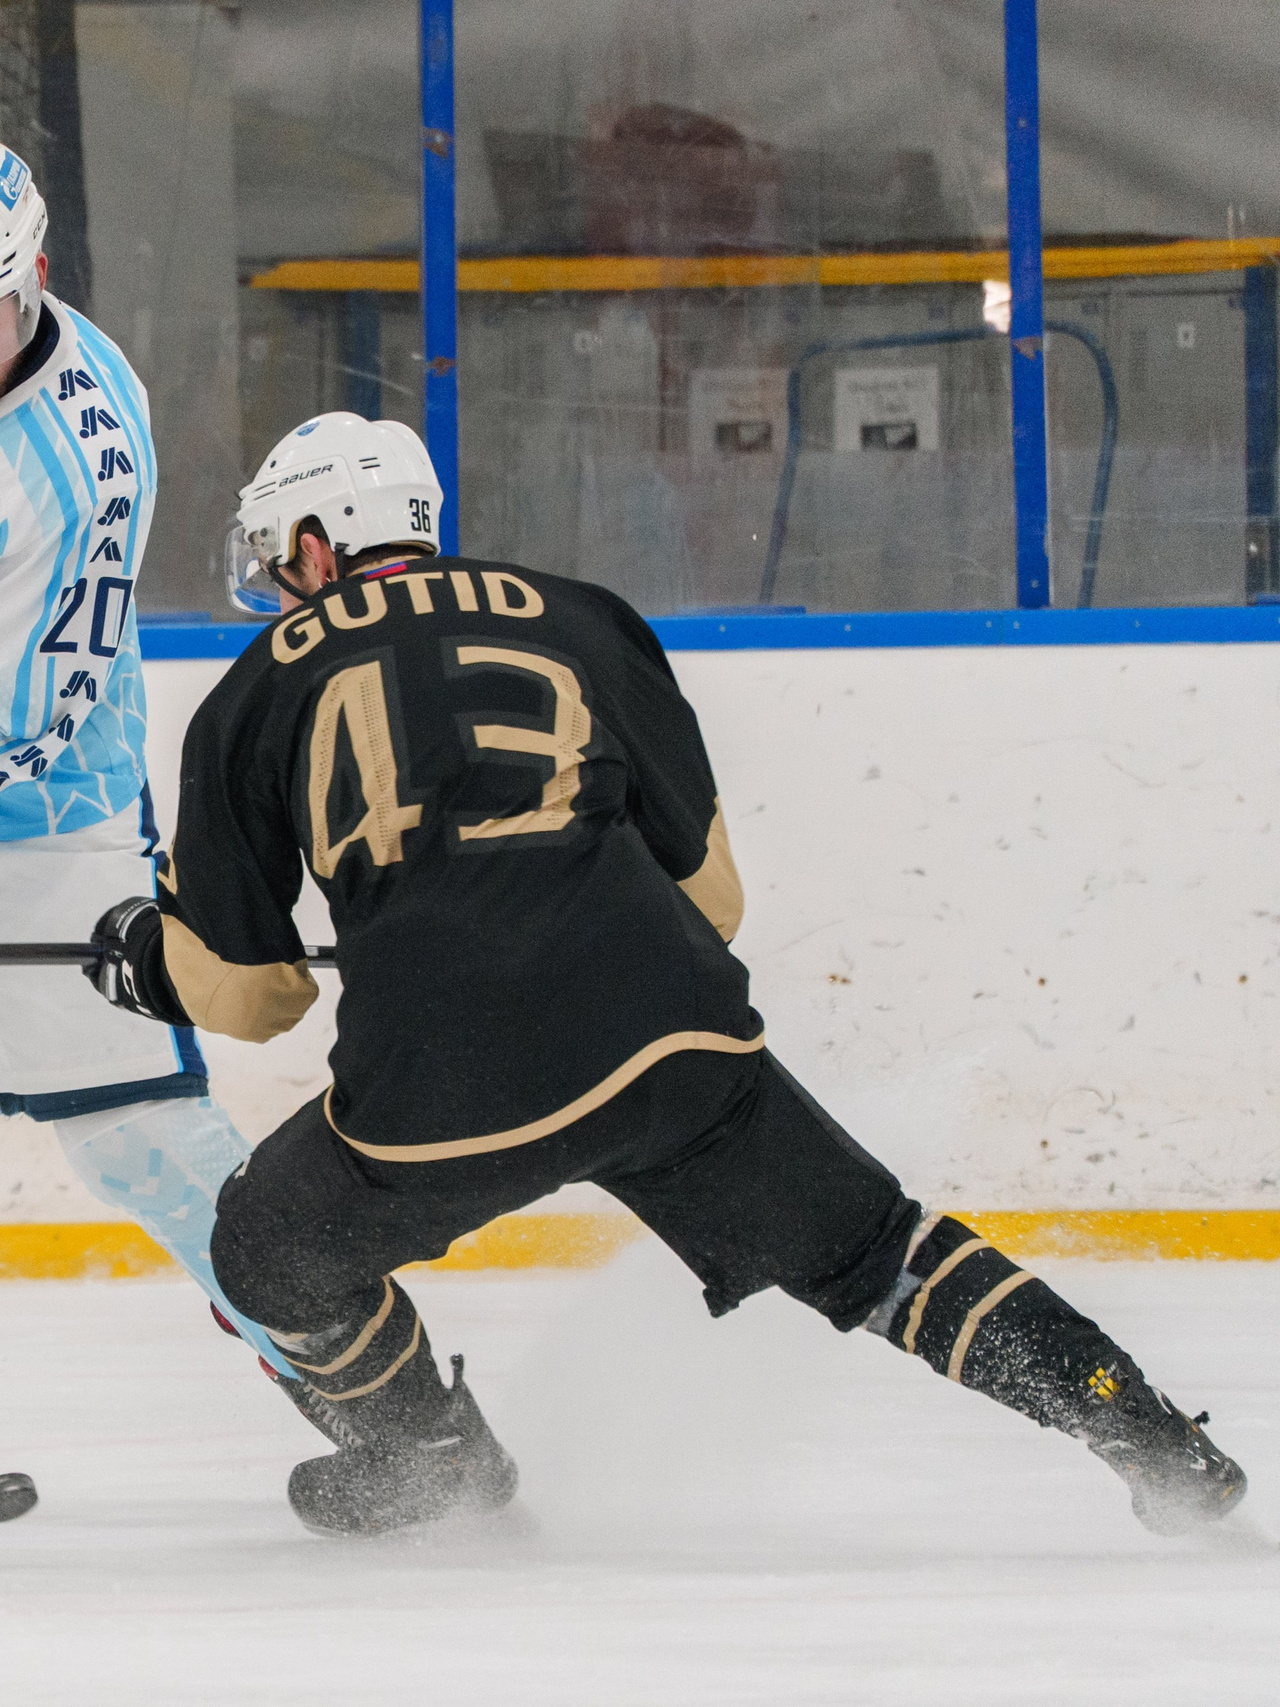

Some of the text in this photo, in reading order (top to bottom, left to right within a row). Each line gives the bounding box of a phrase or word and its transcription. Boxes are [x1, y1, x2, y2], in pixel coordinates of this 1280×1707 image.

[278, 463, 334, 488] BAUER
[409, 498, 432, 533] 36
[39, 576, 134, 659] 20
[271, 570, 545, 665] GUTID
[307, 645, 593, 880] 43
